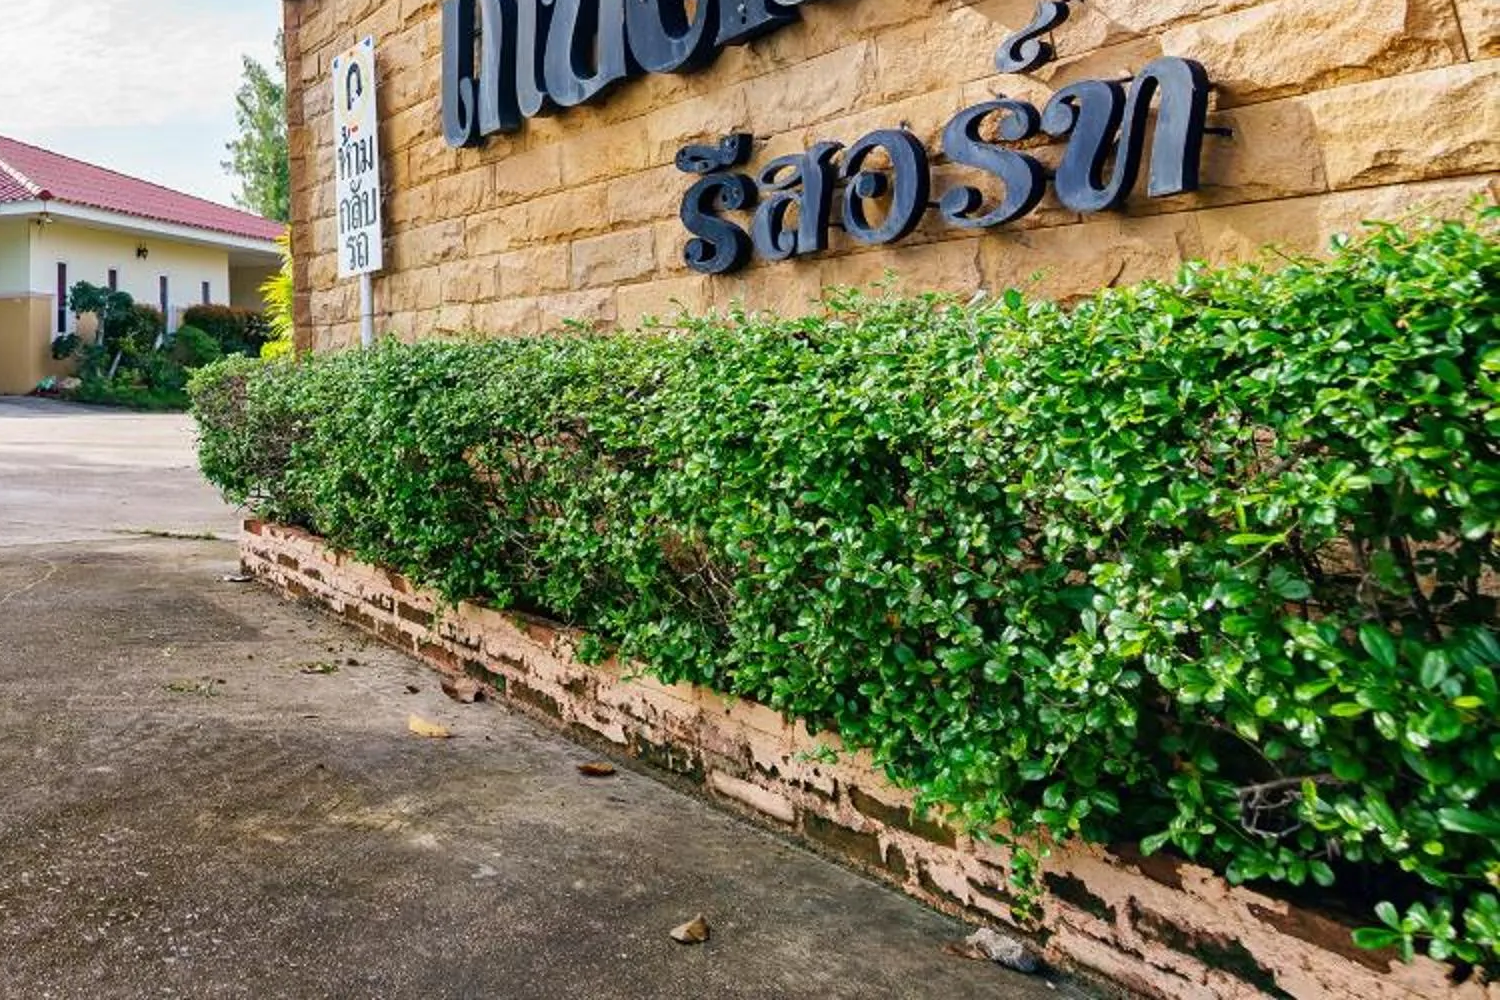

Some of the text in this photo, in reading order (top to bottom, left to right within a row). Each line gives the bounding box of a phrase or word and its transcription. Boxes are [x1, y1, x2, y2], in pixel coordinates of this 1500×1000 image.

[338, 125, 374, 180] ห้าม
[340, 179, 377, 235] กลับ
[346, 231, 370, 270] รถ
